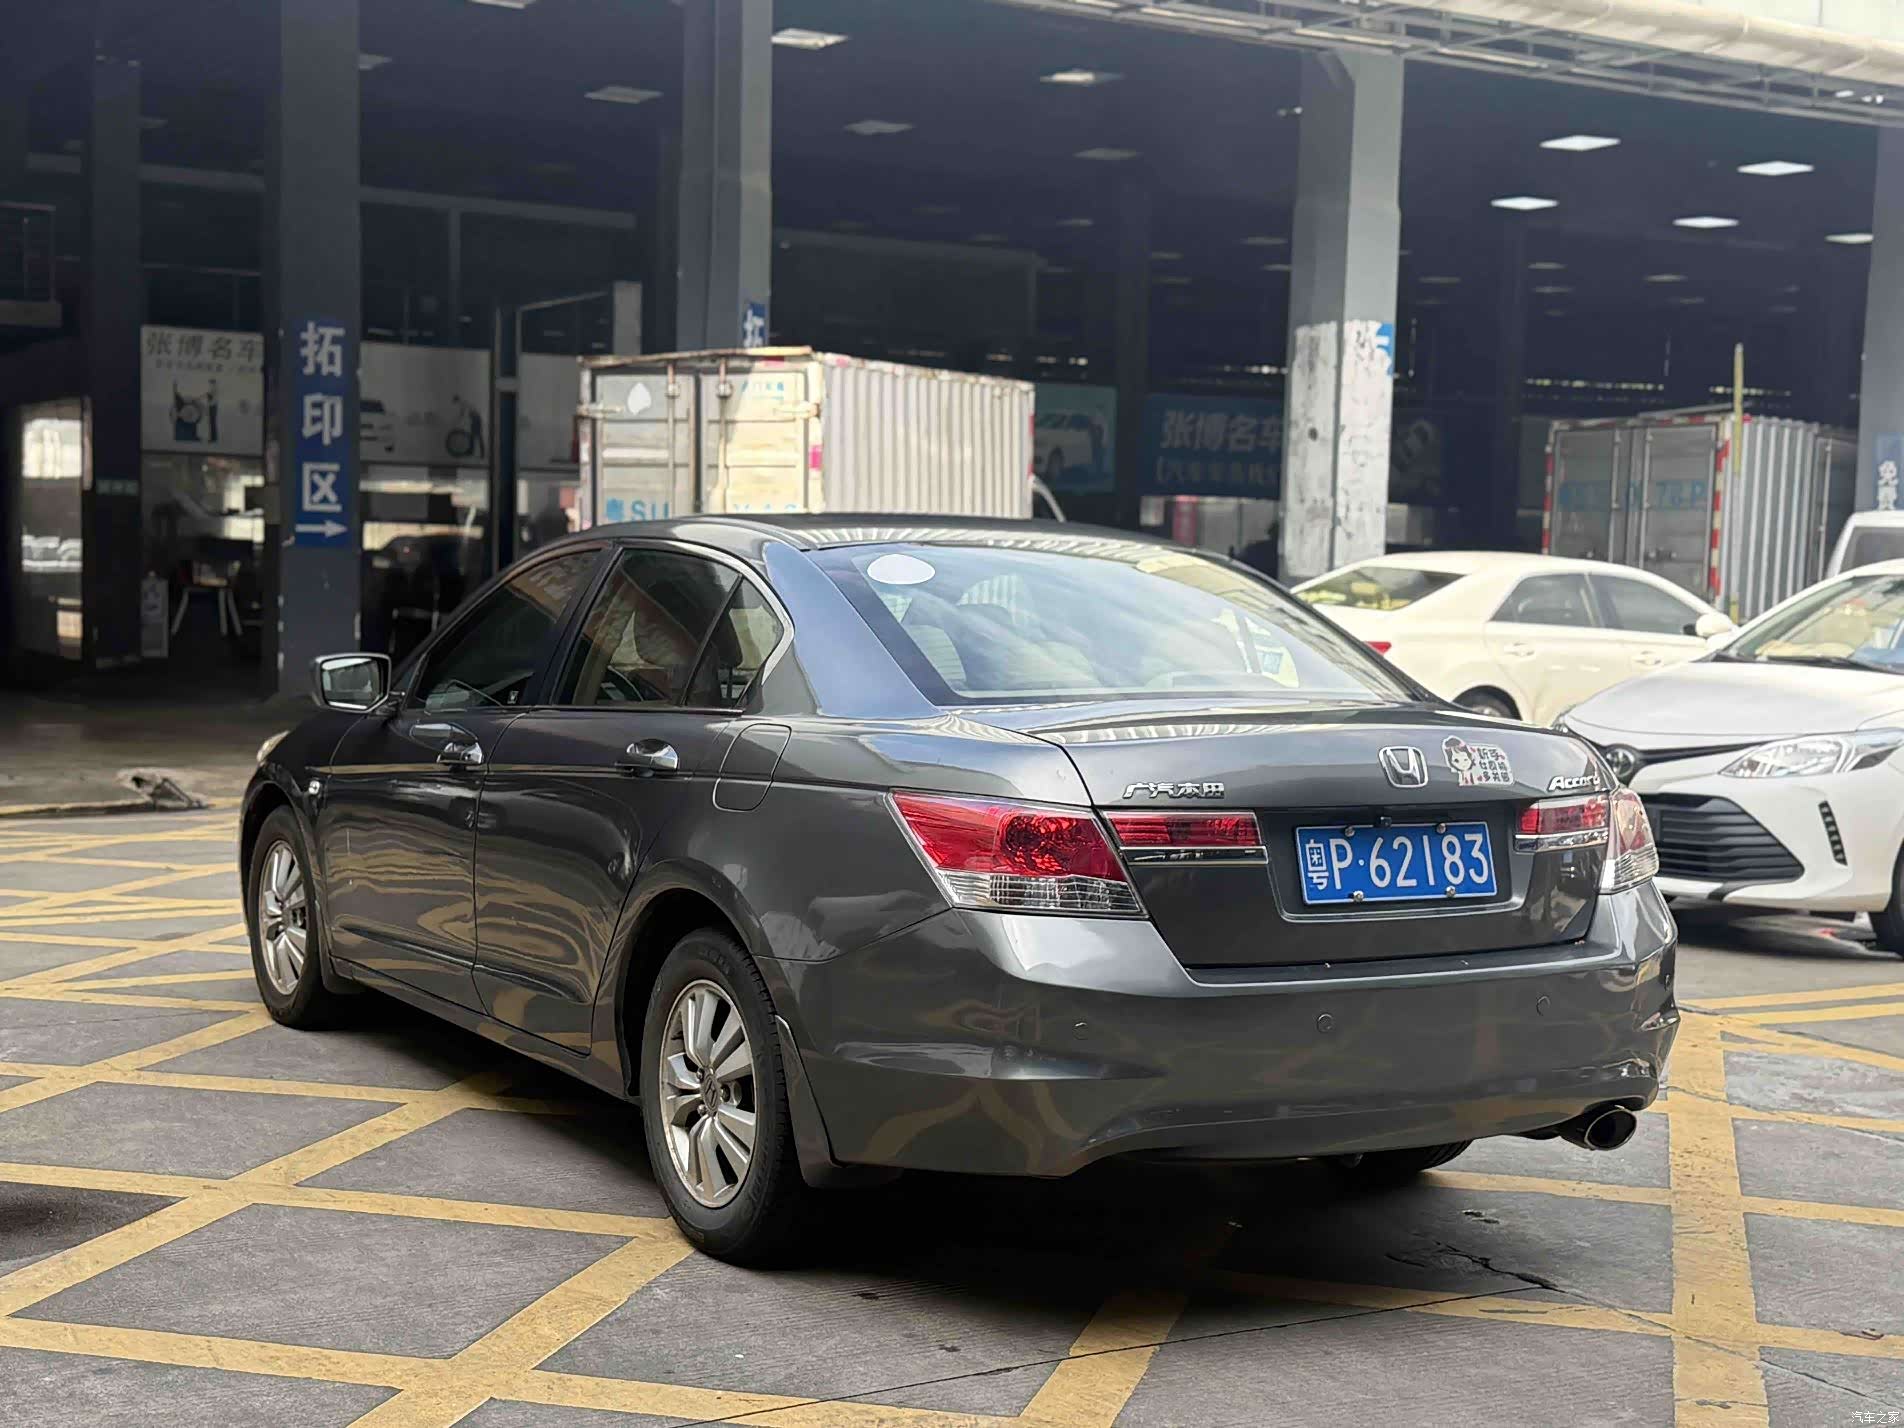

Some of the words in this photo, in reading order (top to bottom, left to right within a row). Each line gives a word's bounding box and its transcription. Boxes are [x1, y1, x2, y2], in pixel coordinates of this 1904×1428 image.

[146, 330, 262, 364] 张博名车
[300, 321, 346, 513] 拓印区
[1160, 408, 1281, 454] 张博名车
[1122, 782, 1225, 799] 广汽本田
